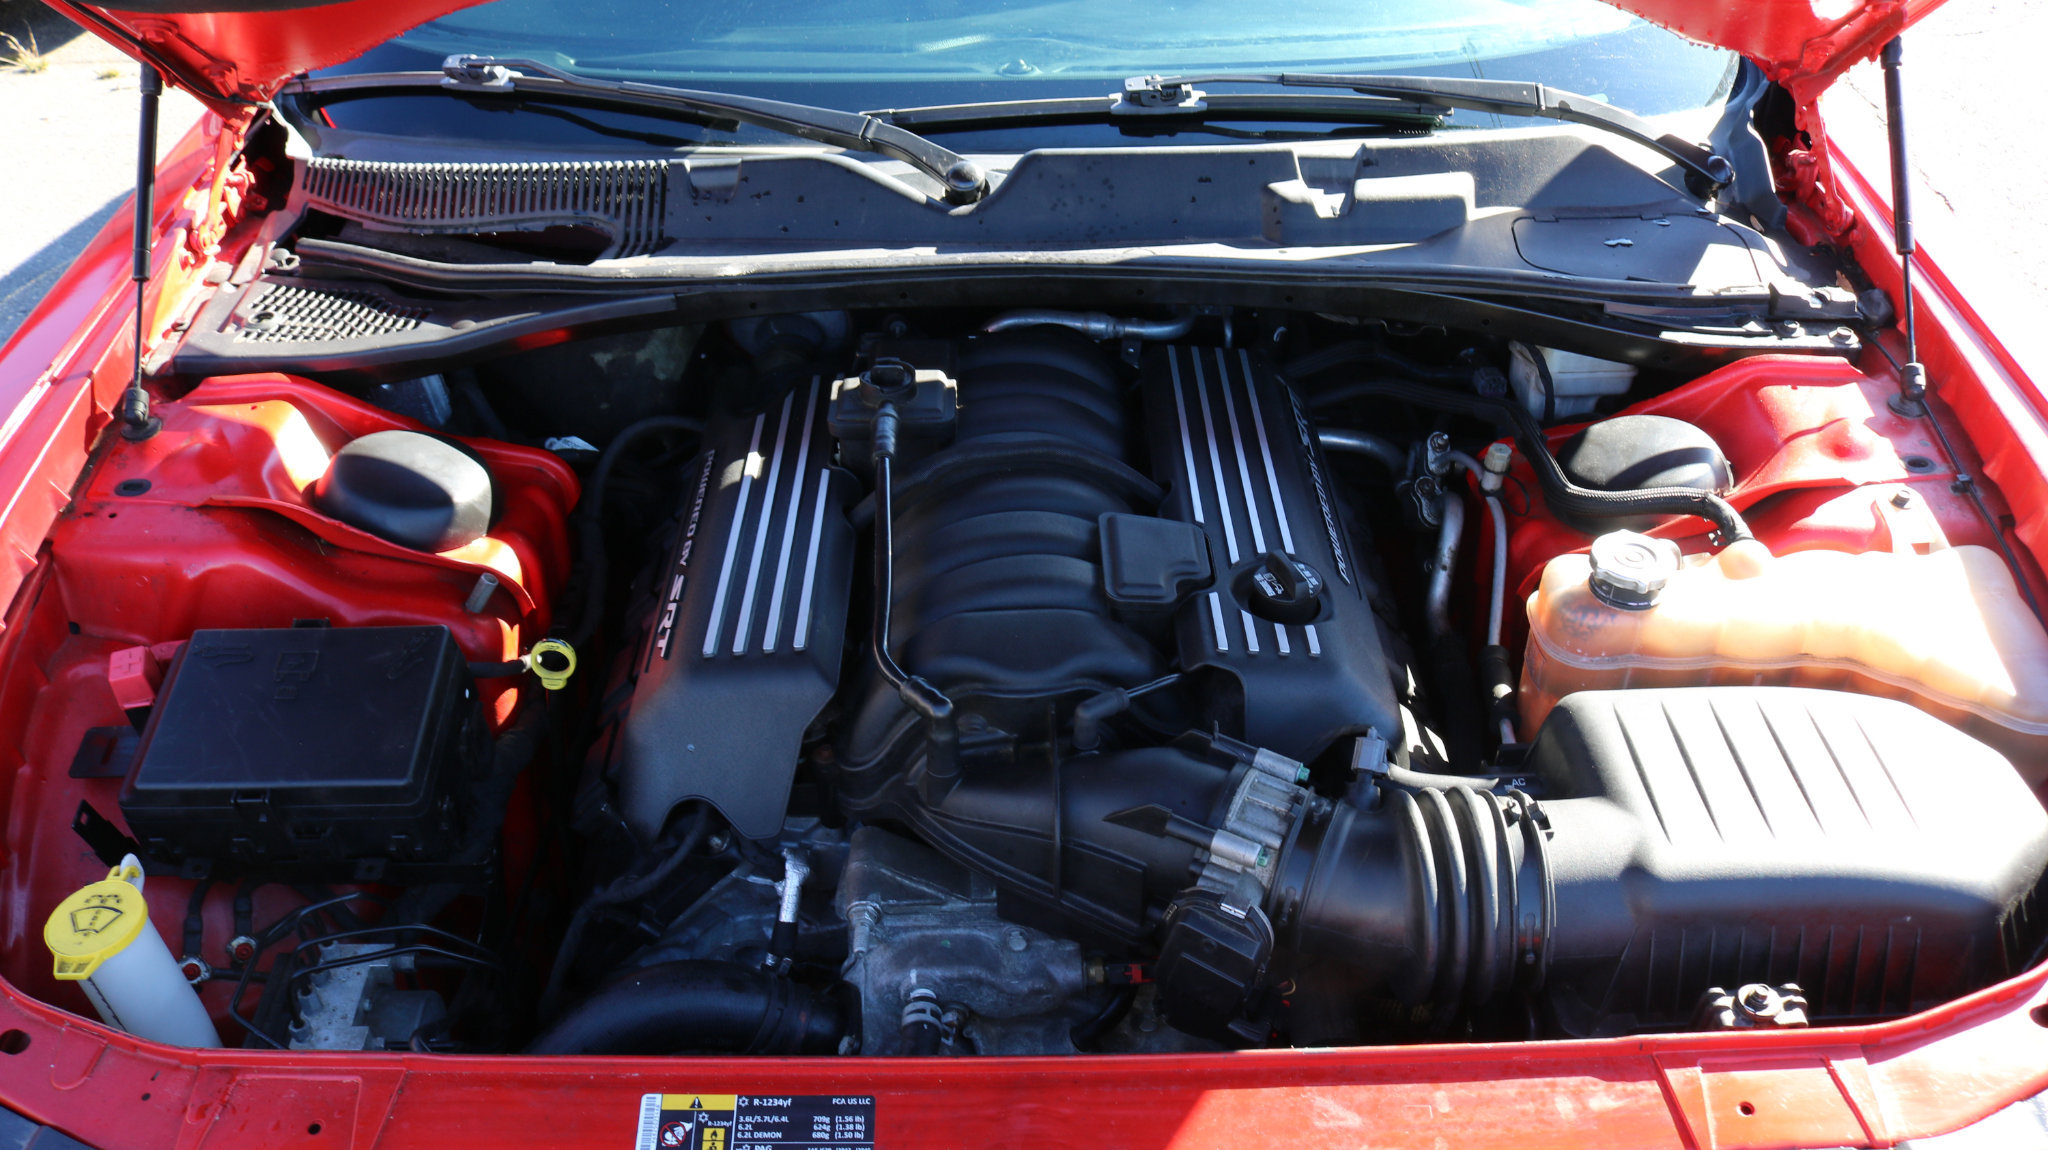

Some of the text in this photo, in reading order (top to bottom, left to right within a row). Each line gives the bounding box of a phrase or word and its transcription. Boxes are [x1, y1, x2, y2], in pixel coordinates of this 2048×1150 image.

[1315, 480, 1351, 585] POWERED
[657, 449, 715, 658] POWERED BY SRT
[753, 1098, 792, 1108] R-1234yf
[737, 1123, 753, 1131] 6.2L
[737, 1131, 753, 1139] 6.2L
[753, 1131, 782, 1139] DEMON
